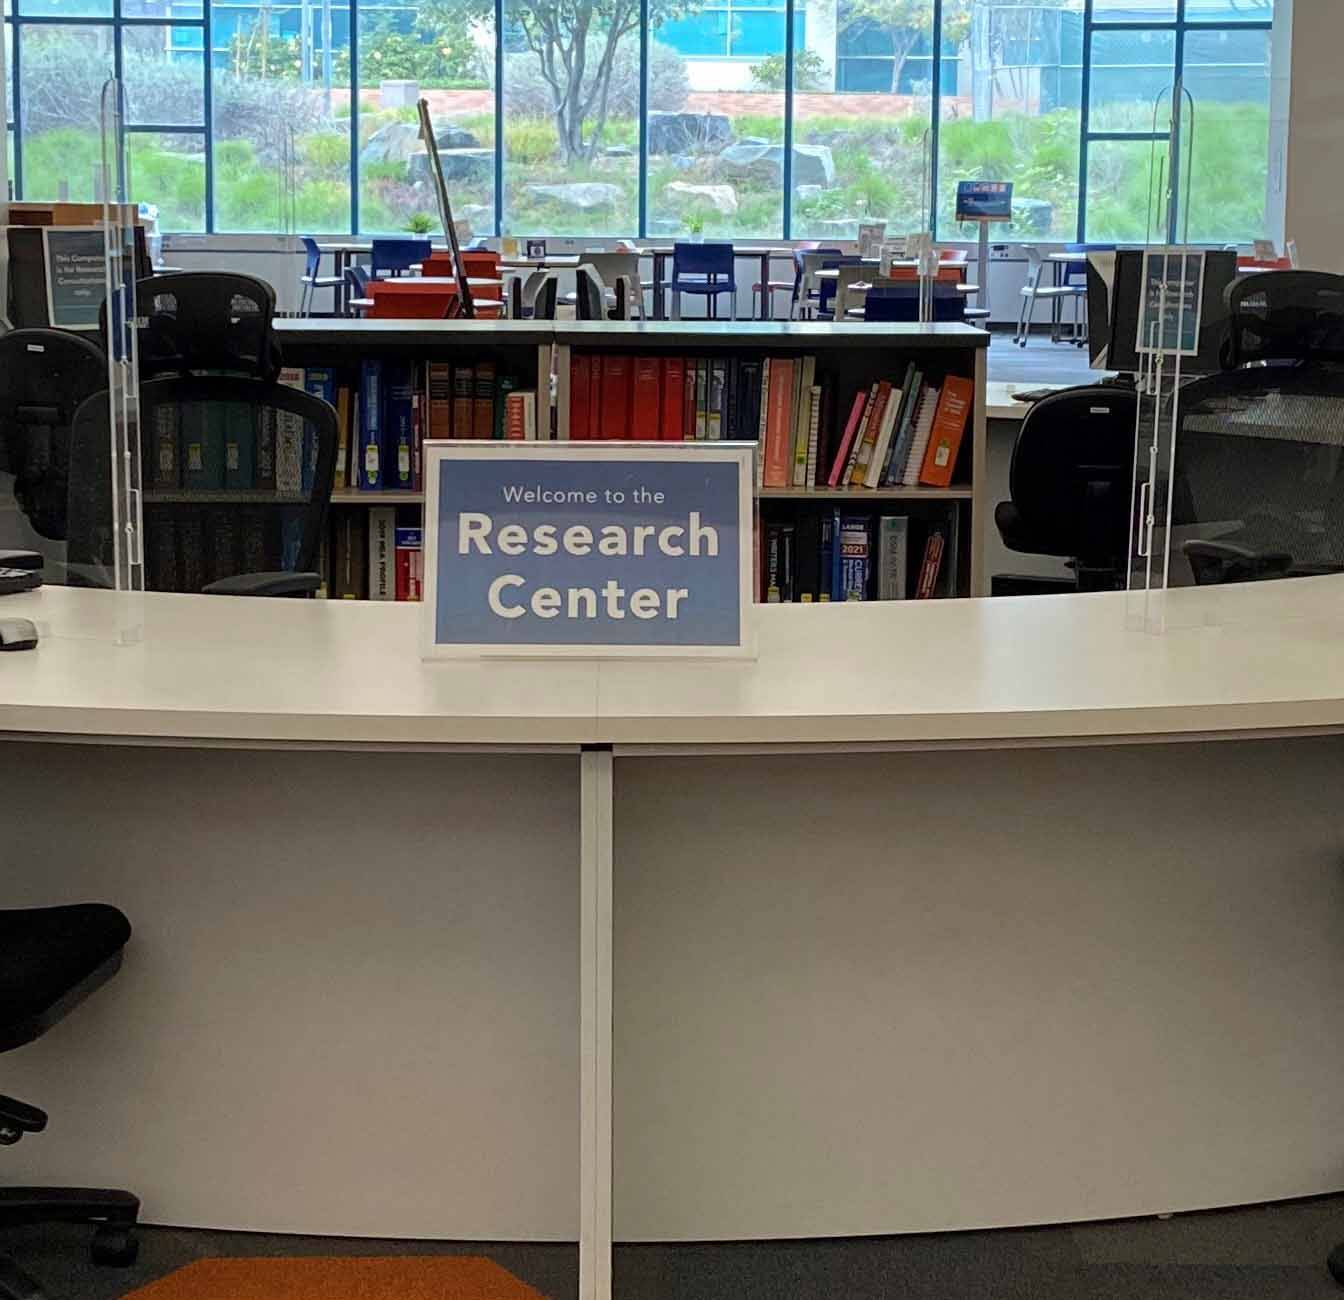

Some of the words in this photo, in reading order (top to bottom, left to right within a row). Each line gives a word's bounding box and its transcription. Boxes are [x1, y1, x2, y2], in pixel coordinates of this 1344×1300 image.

[503, 485, 598, 504] Welcome
[605, 488, 625, 504] to
[632, 487, 665, 504] the
[457, 511, 719, 556] Research
[488, 574, 689, 619] Center
